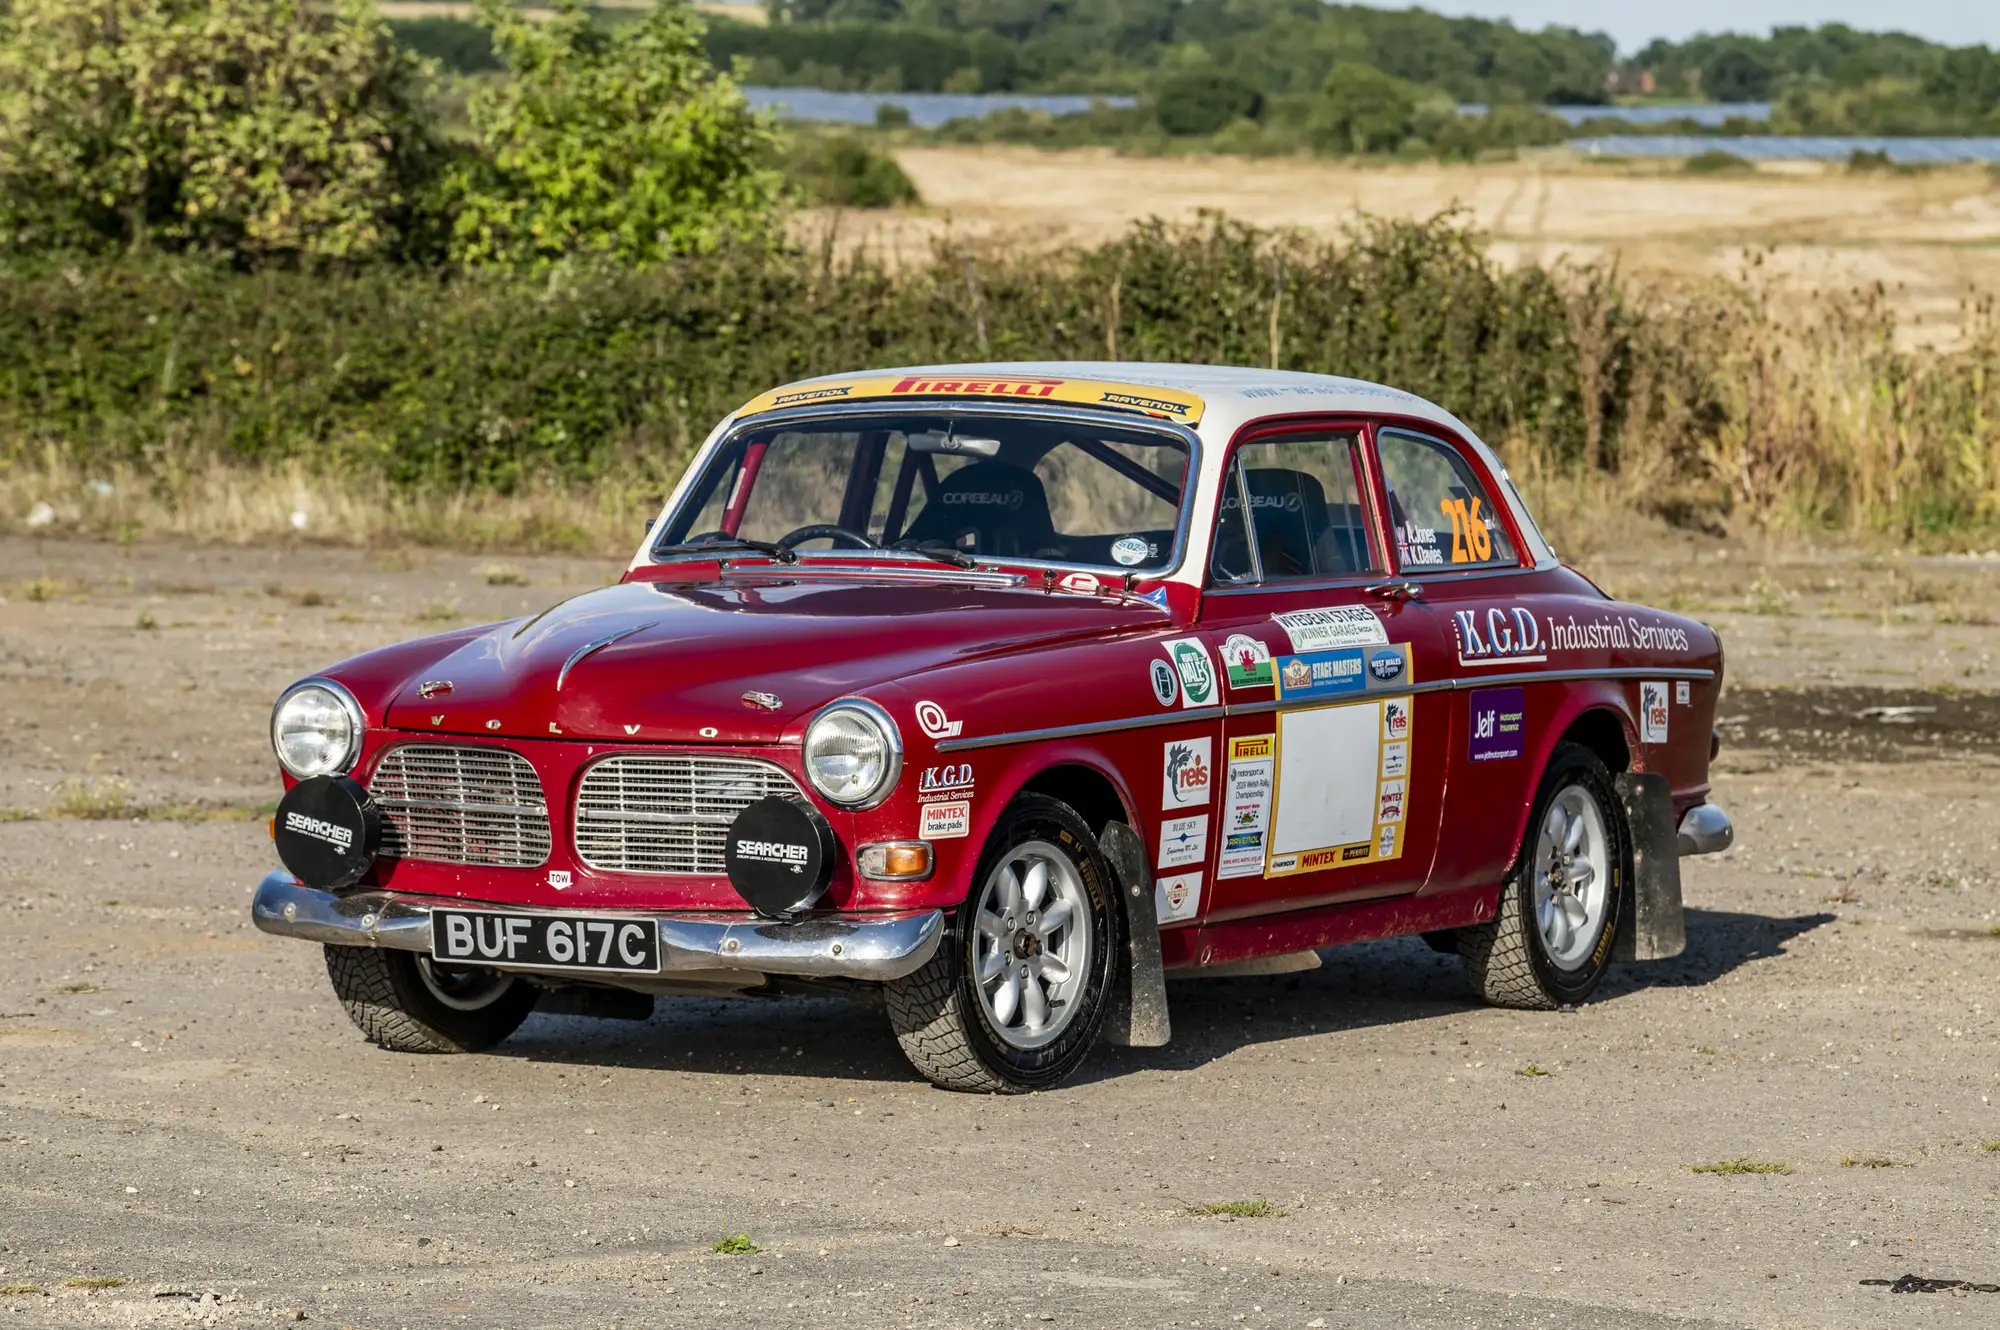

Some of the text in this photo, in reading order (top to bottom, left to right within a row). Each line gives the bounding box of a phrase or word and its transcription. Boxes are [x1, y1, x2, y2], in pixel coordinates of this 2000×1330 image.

[890, 376, 1064, 397] PIRELLI
[778, 388, 844, 403] RAVENOL
[1107, 395, 1182, 412] RAVENOL
[943, 492, 1009, 504] CORBEAU
[1277, 607, 1375, 628] WYEDEAN STAGES
[1298, 623, 1360, 640] WINNER GARAGE
[1465, 606, 1699, 656] K.G.D. Industrial Services
[1312, 662, 1333, 679] STAGE
[1333, 658, 1362, 678] MASTERS
[1371, 657, 1402, 668] WEST WALES
[1650, 695, 1667, 725] reis
[1392, 710, 1407, 729] reis
[1474, 709, 1495, 739] Jelf
[1235, 739, 1269, 757] PIRELLI
[925, 763, 975, 788] K.G.D.
[1180, 754, 1208, 788] reis
[918, 790, 975, 803] Industrial Services
[1236, 789, 1264, 799] Championship
[1381, 791, 1403, 804] MINTEX
[927, 806, 966, 820] MINTEX
[285, 812, 353, 843] SEARCHER
[928, 820, 963, 832] brake pads
[1172, 820, 1196, 832] BLUE SKY
[736, 839, 808, 860] SEARCHER
[1228, 835, 1260, 847] RAVENOL
[1302, 851, 1336, 868] MINTEX
[551, 873, 569, 883] TOW
[1167, 888, 1188, 900] PENRITE
[446, 914, 646, 966] BUF 617C
